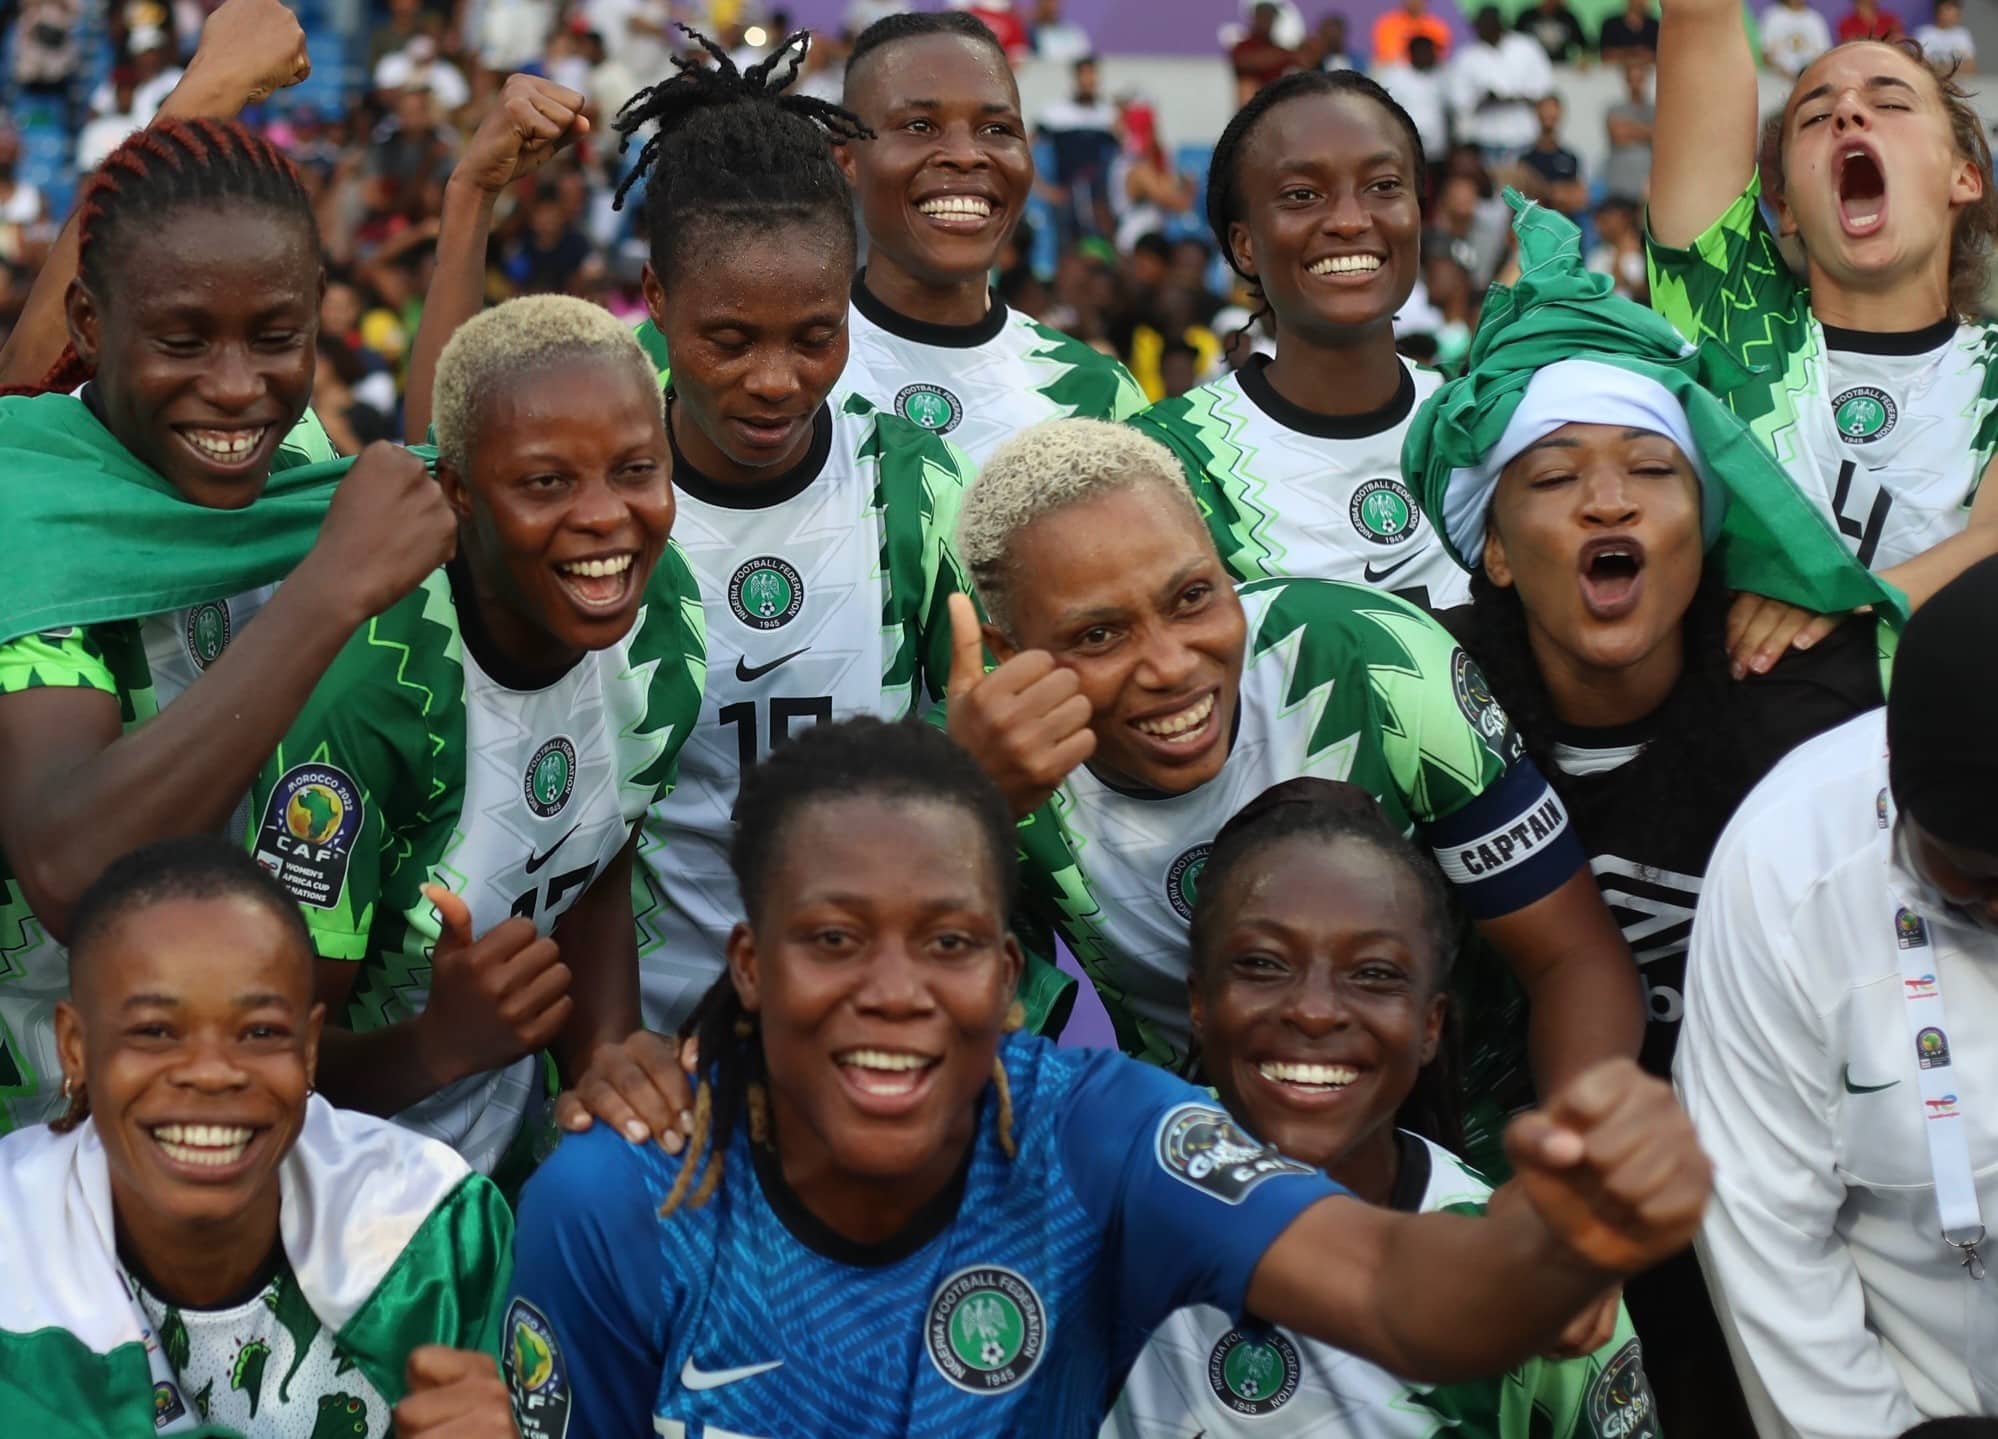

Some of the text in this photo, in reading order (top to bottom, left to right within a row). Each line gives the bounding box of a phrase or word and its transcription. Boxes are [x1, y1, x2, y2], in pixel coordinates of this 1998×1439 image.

[901, 385, 941, 398] FOOTBALL
[1835, 388, 1896, 440] FOOTBALL FEDERATION
[1351, 480, 1418, 539] NIGERIA FOOTBALL FEDERATION
[730, 559, 802, 620] NIGERIA FOOTBALL FEDERATION
[759, 619, 780, 629] 1945
[525, 740, 575, 811] NIGERIA FOOTBALL FEDERATION
[287, 773, 353, 812] MOROCCO 2022
[276, 835, 332, 862] CAF
[1461, 797, 1563, 875] CAPTAIN
[285, 861, 324, 880] WOMEN'S
[1169, 847, 1213, 880] FOOTBAL
[282, 872, 312, 888] AFRICA
[313, 881, 330, 892] CUP
[291, 886, 327, 902] NATIONS
[933, 1273, 1040, 1379] NIGERIA FOOTBALL FEDERATION
[985, 1368, 1016, 1387] 1945
[1211, 1346, 1227, 1390] NIGERIA
[1270, 1343, 1298, 1408] FEDERATION
[1232, 1400, 1257, 1414] 1945
